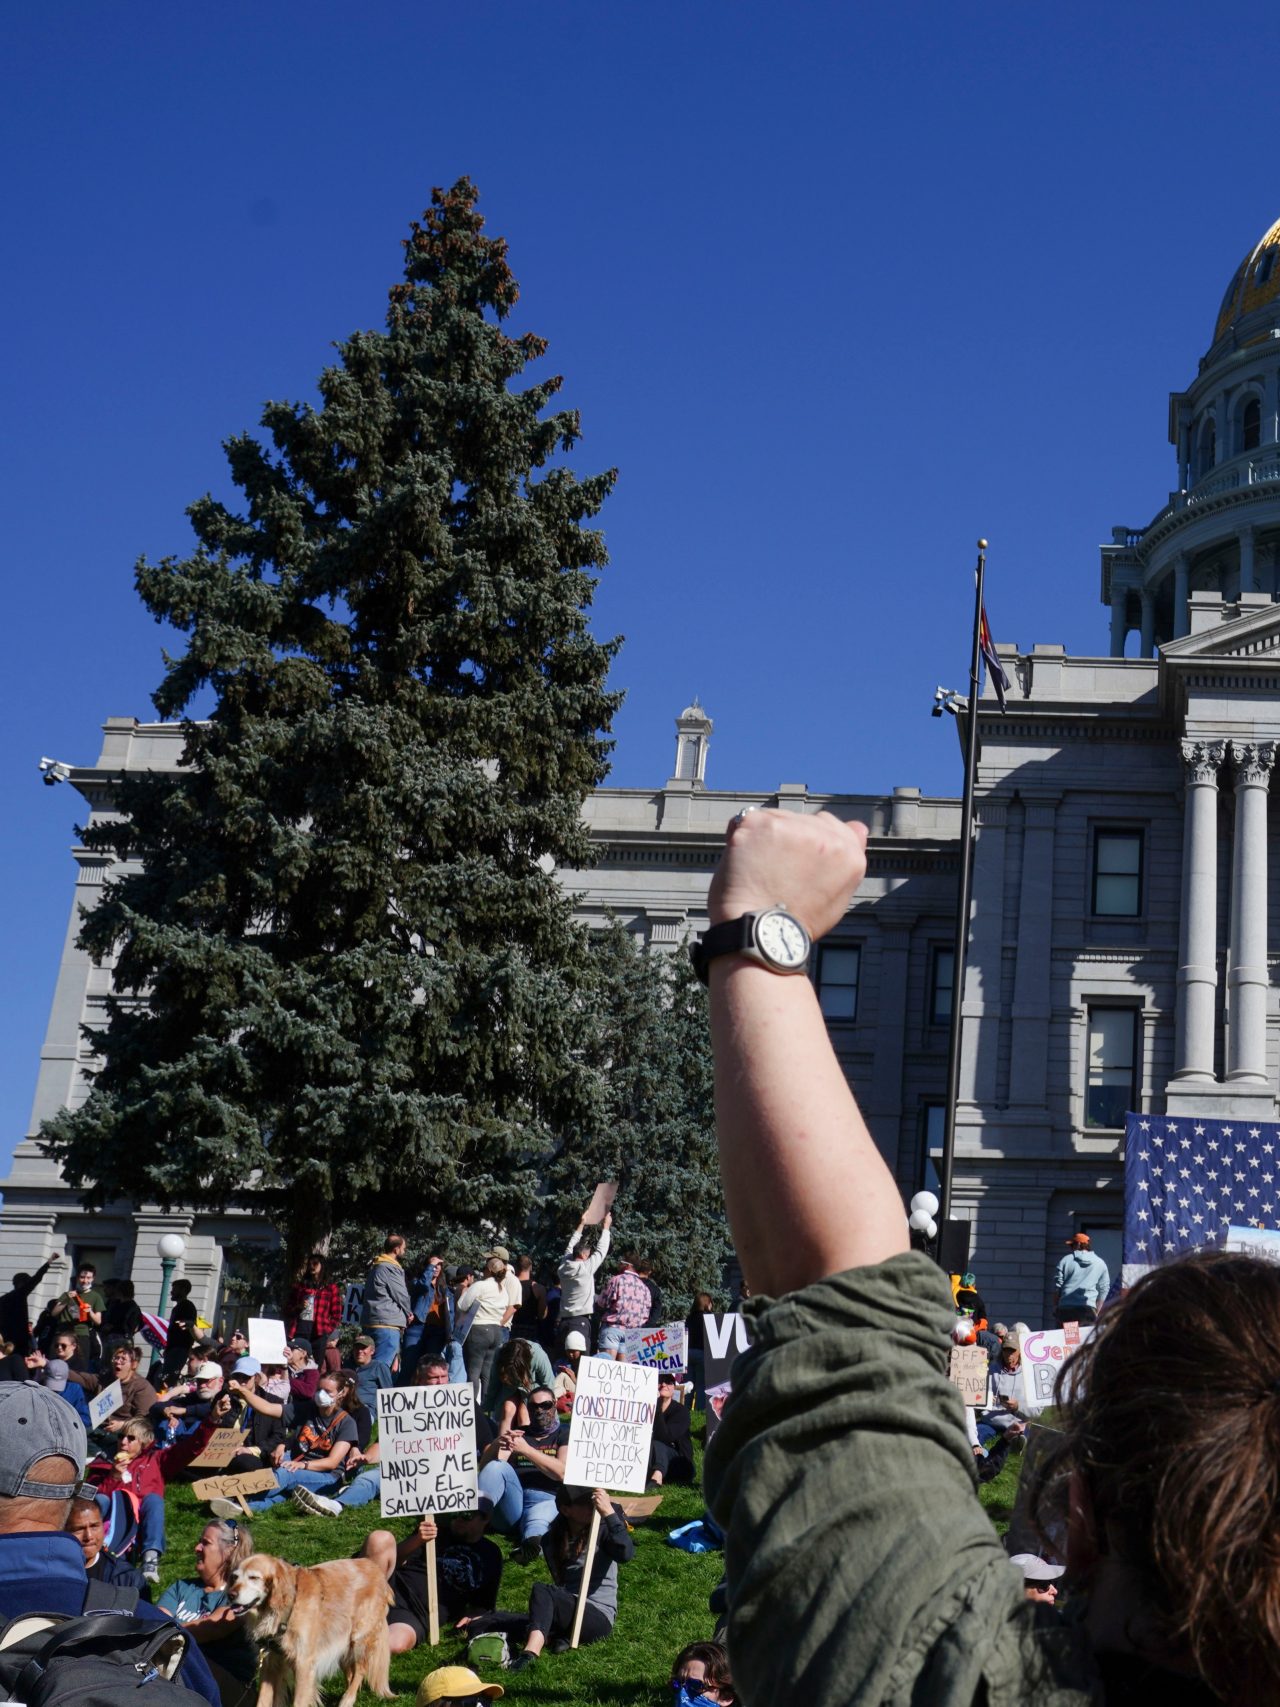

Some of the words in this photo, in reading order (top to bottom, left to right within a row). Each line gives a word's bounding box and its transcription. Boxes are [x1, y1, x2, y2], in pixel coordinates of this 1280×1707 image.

[642, 1329, 668, 1347] THE
[632, 1354, 683, 1370] ADICAL
[638, 1342, 664, 1361] LEFT
[588, 1360, 651, 1384] LOYALTY
[599, 1380, 613, 1396] TO
[620, 1385, 640, 1397] MY
[380, 1392, 418, 1414] HOW
[424, 1389, 471, 1409] LONG
[576, 1395, 656, 1424] CONSTITUTION
[414, 1409, 474, 1432] SAYING
[581, 1421, 607, 1439] NOT
[611, 1424, 641, 1444] SOME
[574, 1440, 610, 1459] TINY
[611, 1443, 642, 1464] DICK
[380, 1459, 430, 1480] LANDS
[443, 1452, 473, 1472] ME
[586, 1462, 633, 1485] PEDO!
[204, 1478, 240, 1490] NO
[220, 1480, 275, 1496] KINGS
[400, 1479, 417, 1495] IN
[435, 1474, 463, 1492] EL
[385, 1488, 476, 1516] SALVADOR?
